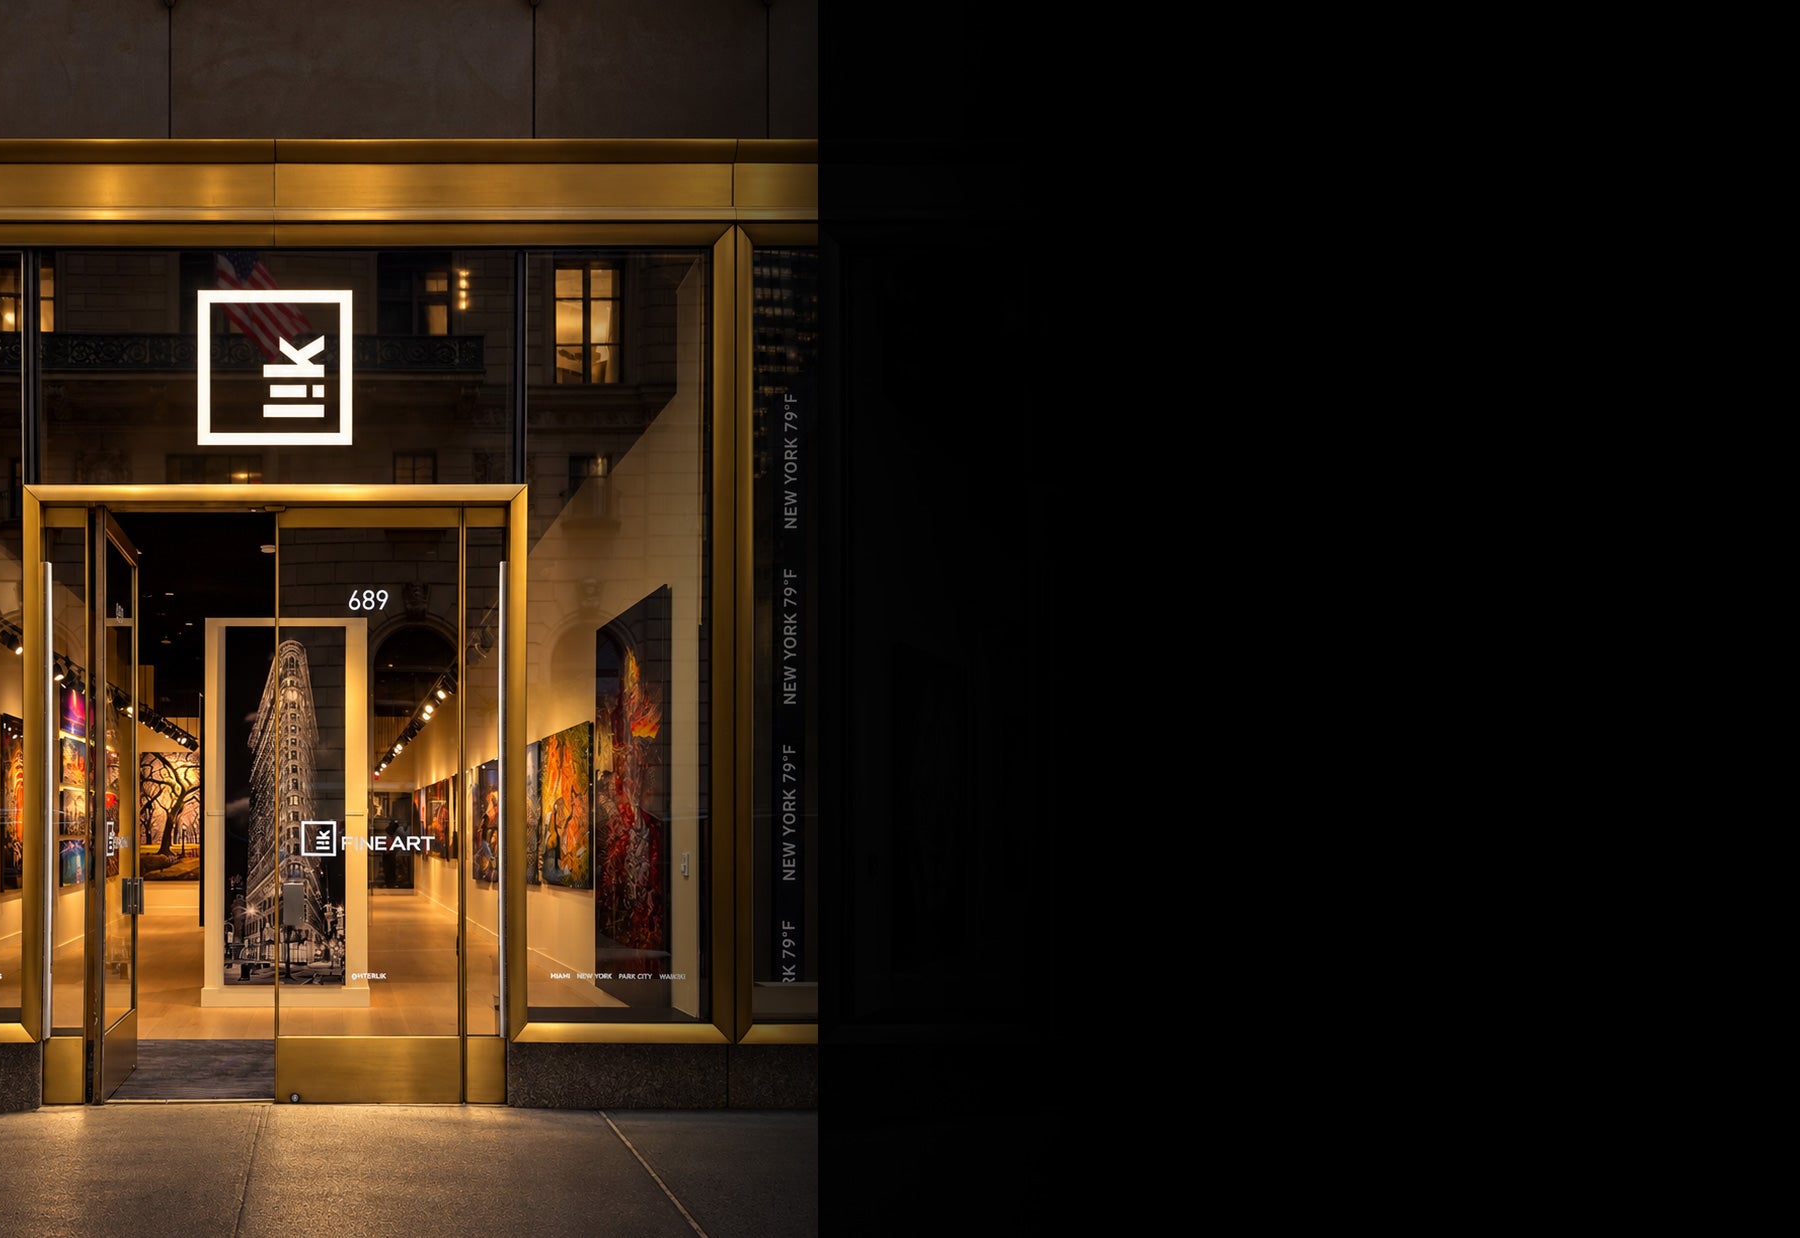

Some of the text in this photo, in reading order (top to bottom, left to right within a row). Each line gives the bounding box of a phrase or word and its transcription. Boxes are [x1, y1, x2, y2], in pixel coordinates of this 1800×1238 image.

[784, 393, 798, 529] NEW YORK 79°F
[348, 589, 389, 611] 689
[783, 568, 797, 705] NEW YORK 79°F
[782, 744, 796, 881] NEW YORK 79°F
[341, 836, 388, 851] FINE
[389, 836, 436, 851] ART
[782, 920, 796, 959] 79°F
[576, 972, 594, 980] NEW
